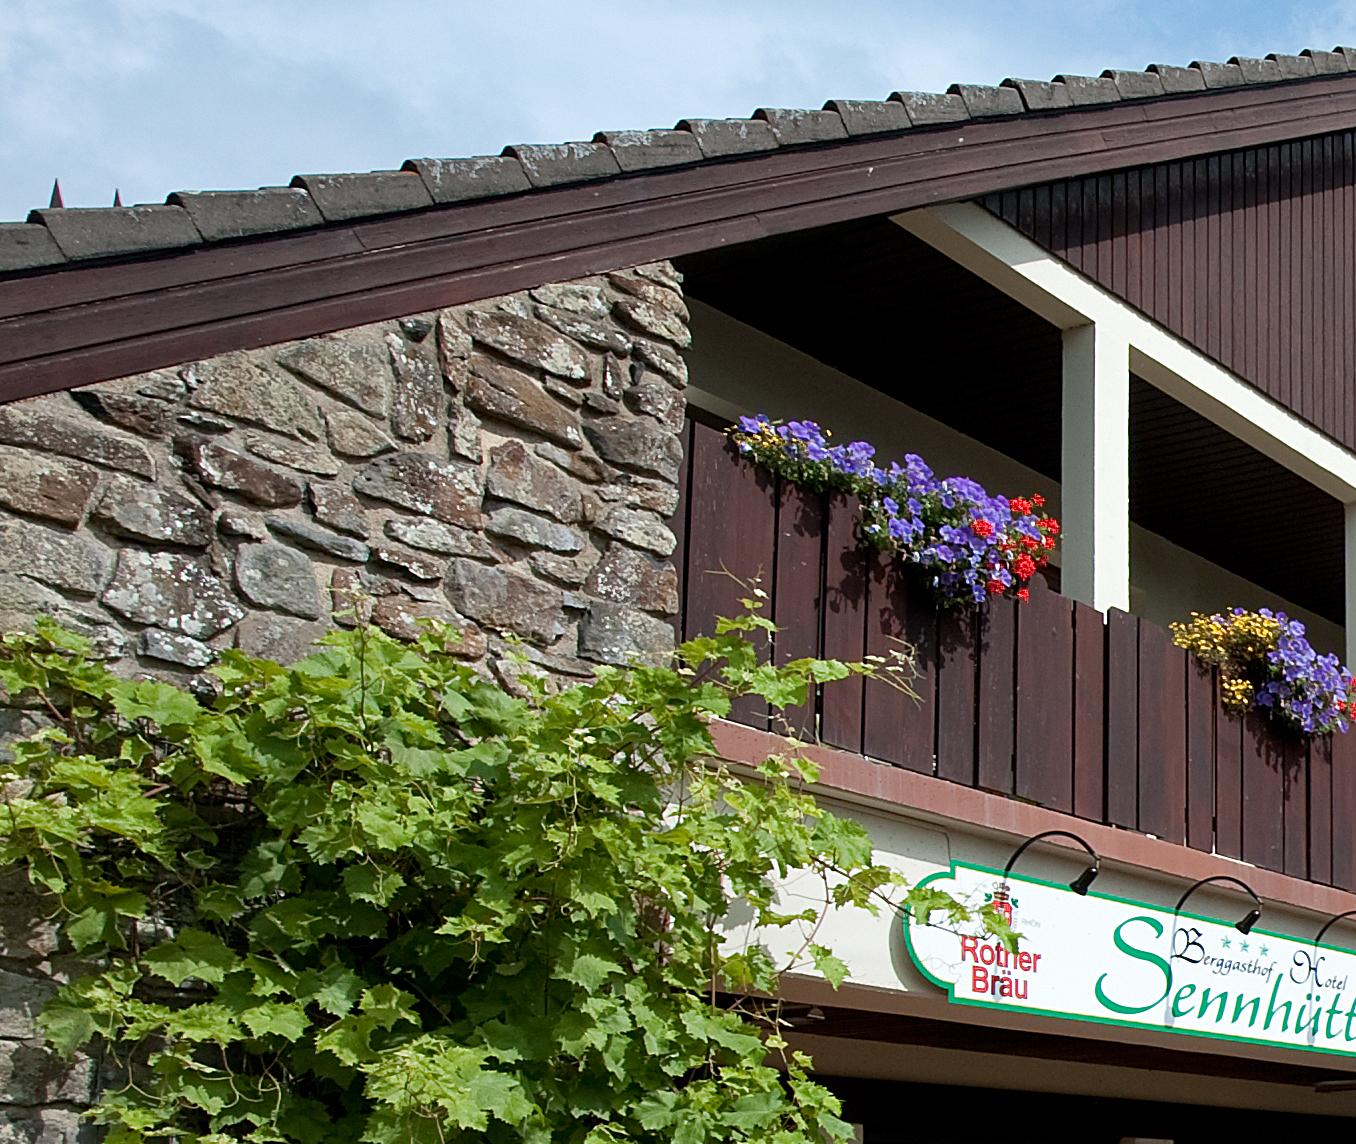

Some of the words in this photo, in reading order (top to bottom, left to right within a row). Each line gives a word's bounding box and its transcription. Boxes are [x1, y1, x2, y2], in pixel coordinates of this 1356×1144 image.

[971, 965, 1028, 1000] Bräu
[1170, 928, 1277, 983] Berggasthof
[1290, 950, 1348, 991] Hotel
